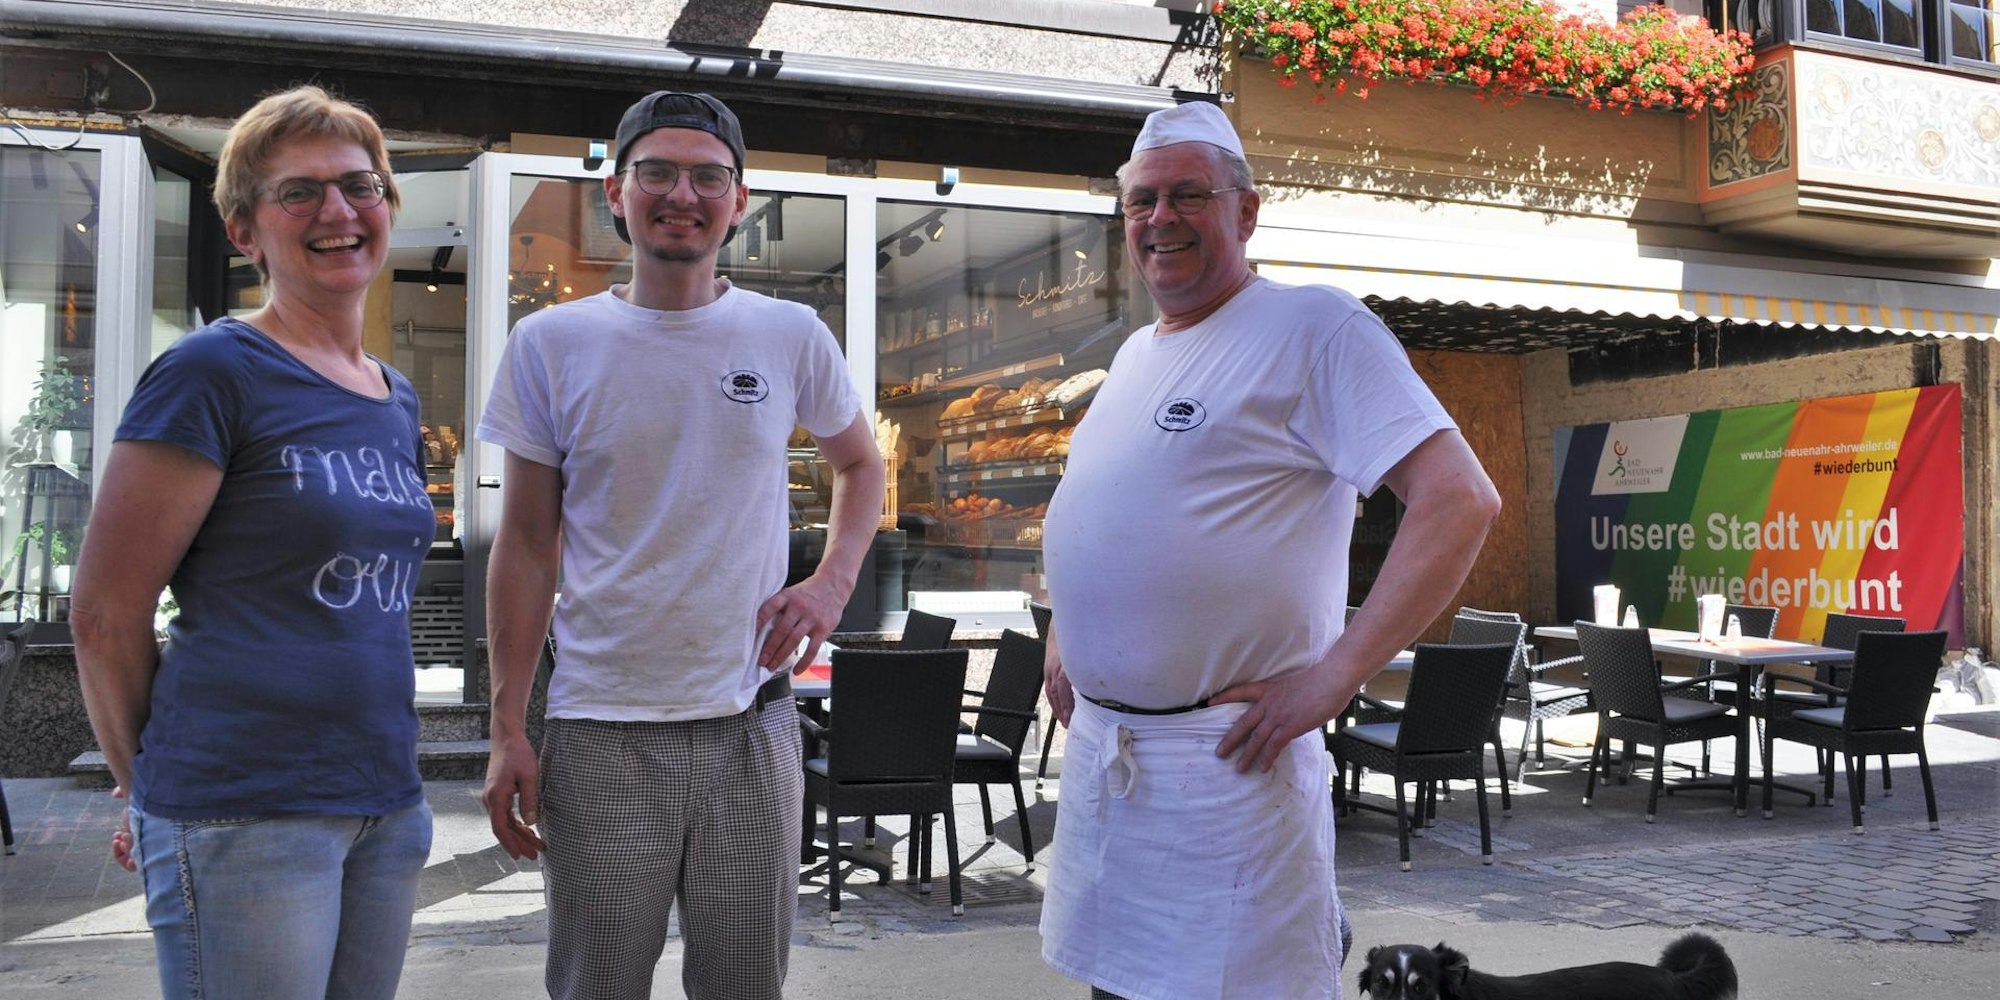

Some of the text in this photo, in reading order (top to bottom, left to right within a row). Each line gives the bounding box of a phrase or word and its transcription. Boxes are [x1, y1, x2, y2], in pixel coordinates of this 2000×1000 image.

[1018, 258, 1105, 308] Schmitz
[732, 388, 759, 397] Schmitz
[1163, 416, 1191, 425] Schmitz
[1740, 439, 1897, 461] www.bad-neuenahr-ahrweiler.de
[1814, 458, 1899, 476] #wiederbunt
[1591, 507, 1899, 551] Unsere Stadt wird
[313, 537, 421, 612] oui
[1667, 566, 1903, 613] #wiederbunt
